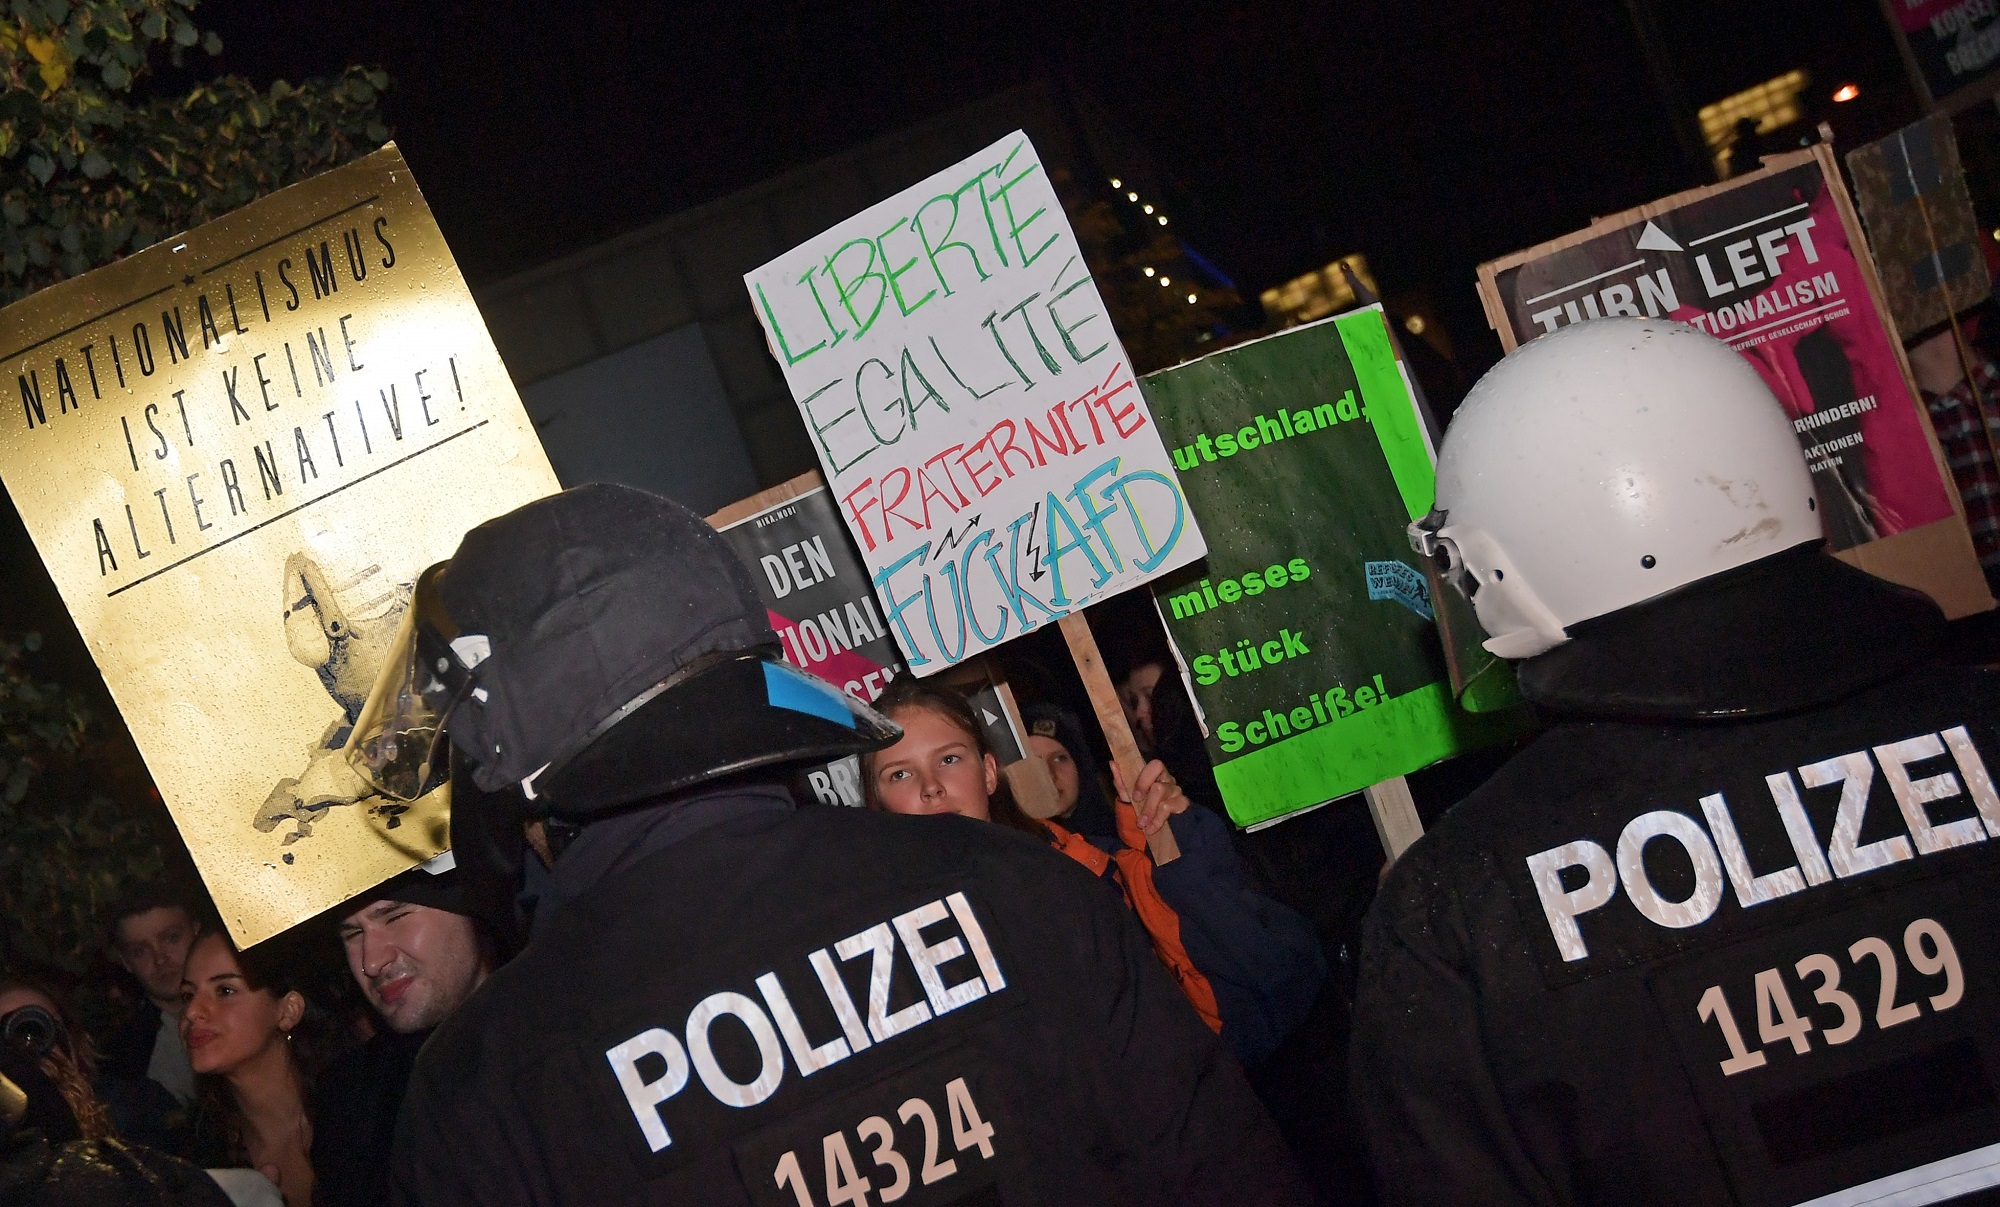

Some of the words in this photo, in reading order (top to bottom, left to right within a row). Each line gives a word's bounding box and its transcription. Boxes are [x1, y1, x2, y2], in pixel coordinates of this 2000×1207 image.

[755, 139, 1060, 368] LIBERTÉ
[1678, 271, 1840, 337] TIONALISM
[1696, 217, 1817, 299] LEFT
[18, 216, 397, 430] NATIONALISMUS
[801, 256, 1110, 478] EGALITÉ
[1768, 316, 1822, 340] GESELLSCHAFT
[121, 389, 194, 472] IST
[222, 314, 365, 426] KEINE
[1168, 390, 1371, 473] utschland,
[1791, 395, 1877, 434] RHINDERN!
[1803, 431, 1864, 461] AKTIONEN
[92, 357, 467, 577] ALTERNATIVE!
[841, 362, 1147, 553] FRATERNITÉ
[756, 506, 797, 529] NIKA.MOBI
[760, 534, 837, 600] DEN
[873, 511, 1071, 666] FUCK
[1041, 456, 1188, 607] AFD
[1169, 557, 1312, 621] mieses
[1192, 628, 1311, 686] Stück
[1217, 673, 1391, 754] Scheiße!
[1525, 724, 2000, 963] POLIZEI
[605, 891, 1007, 1154] POLIZEI
[1695, 917, 1966, 1078] 14329
[773, 1076, 996, 1207] 14324
